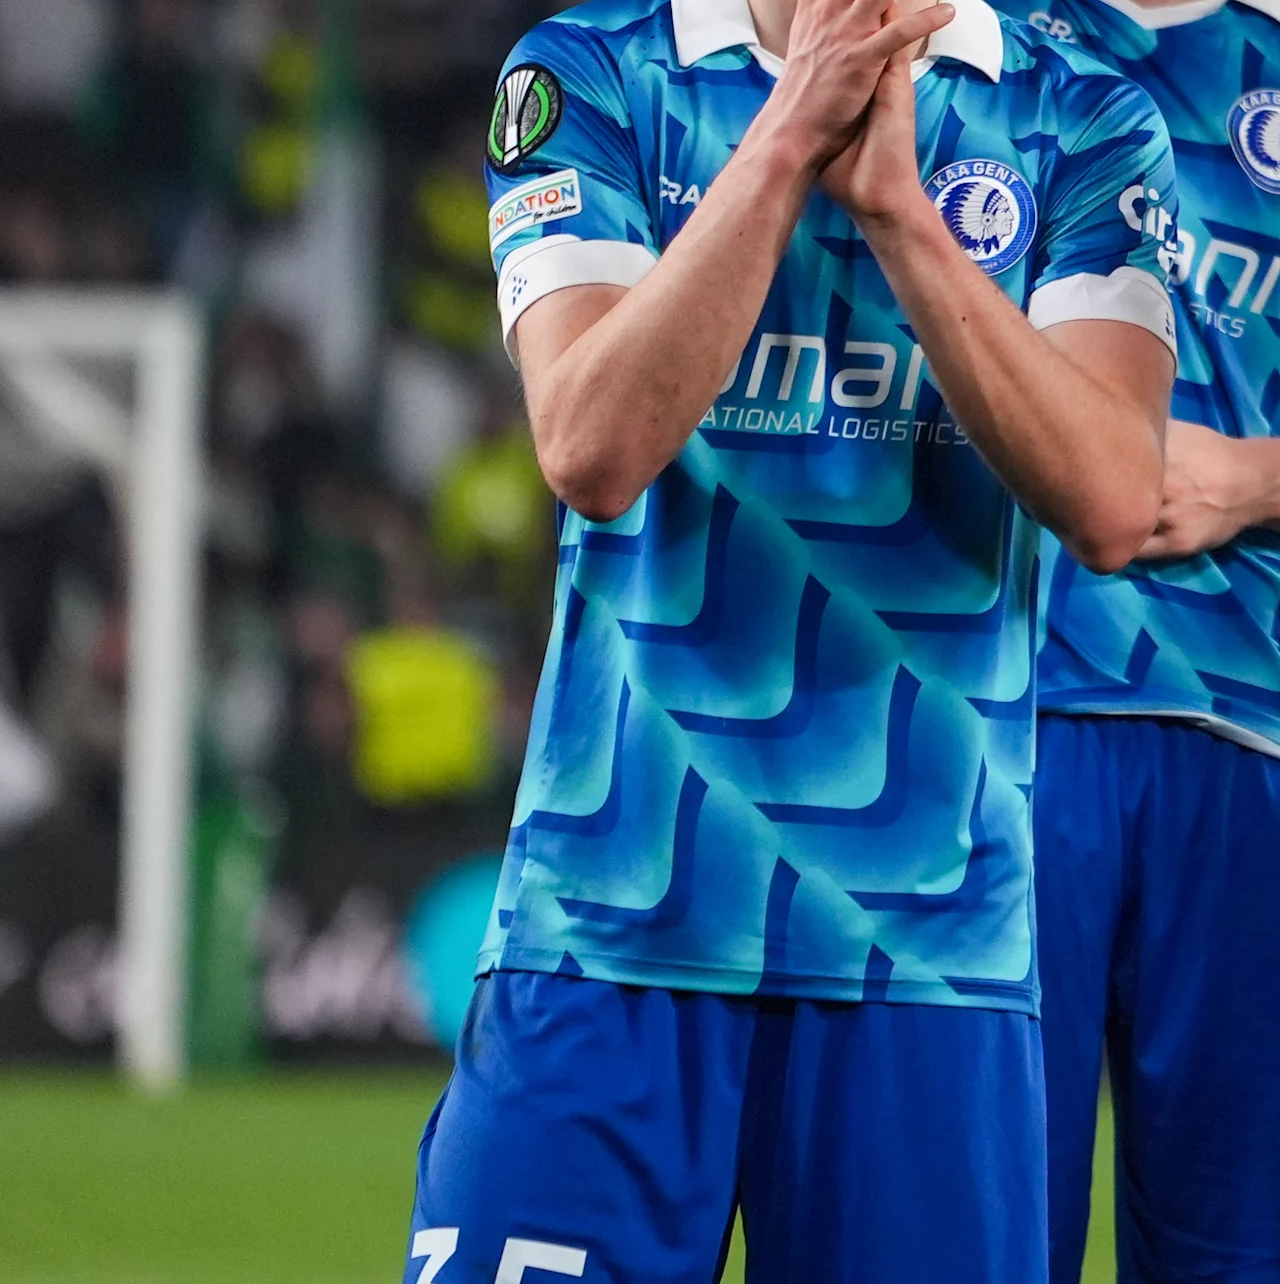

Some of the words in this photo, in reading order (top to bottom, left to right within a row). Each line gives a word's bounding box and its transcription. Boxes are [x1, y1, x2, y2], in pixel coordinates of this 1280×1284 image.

[1239, 93, 1270, 114] KAA
[931, 163, 971, 190] KAA
[971, 161, 1020, 187] GENT
[827, 415, 971, 446] LOGISTICS
